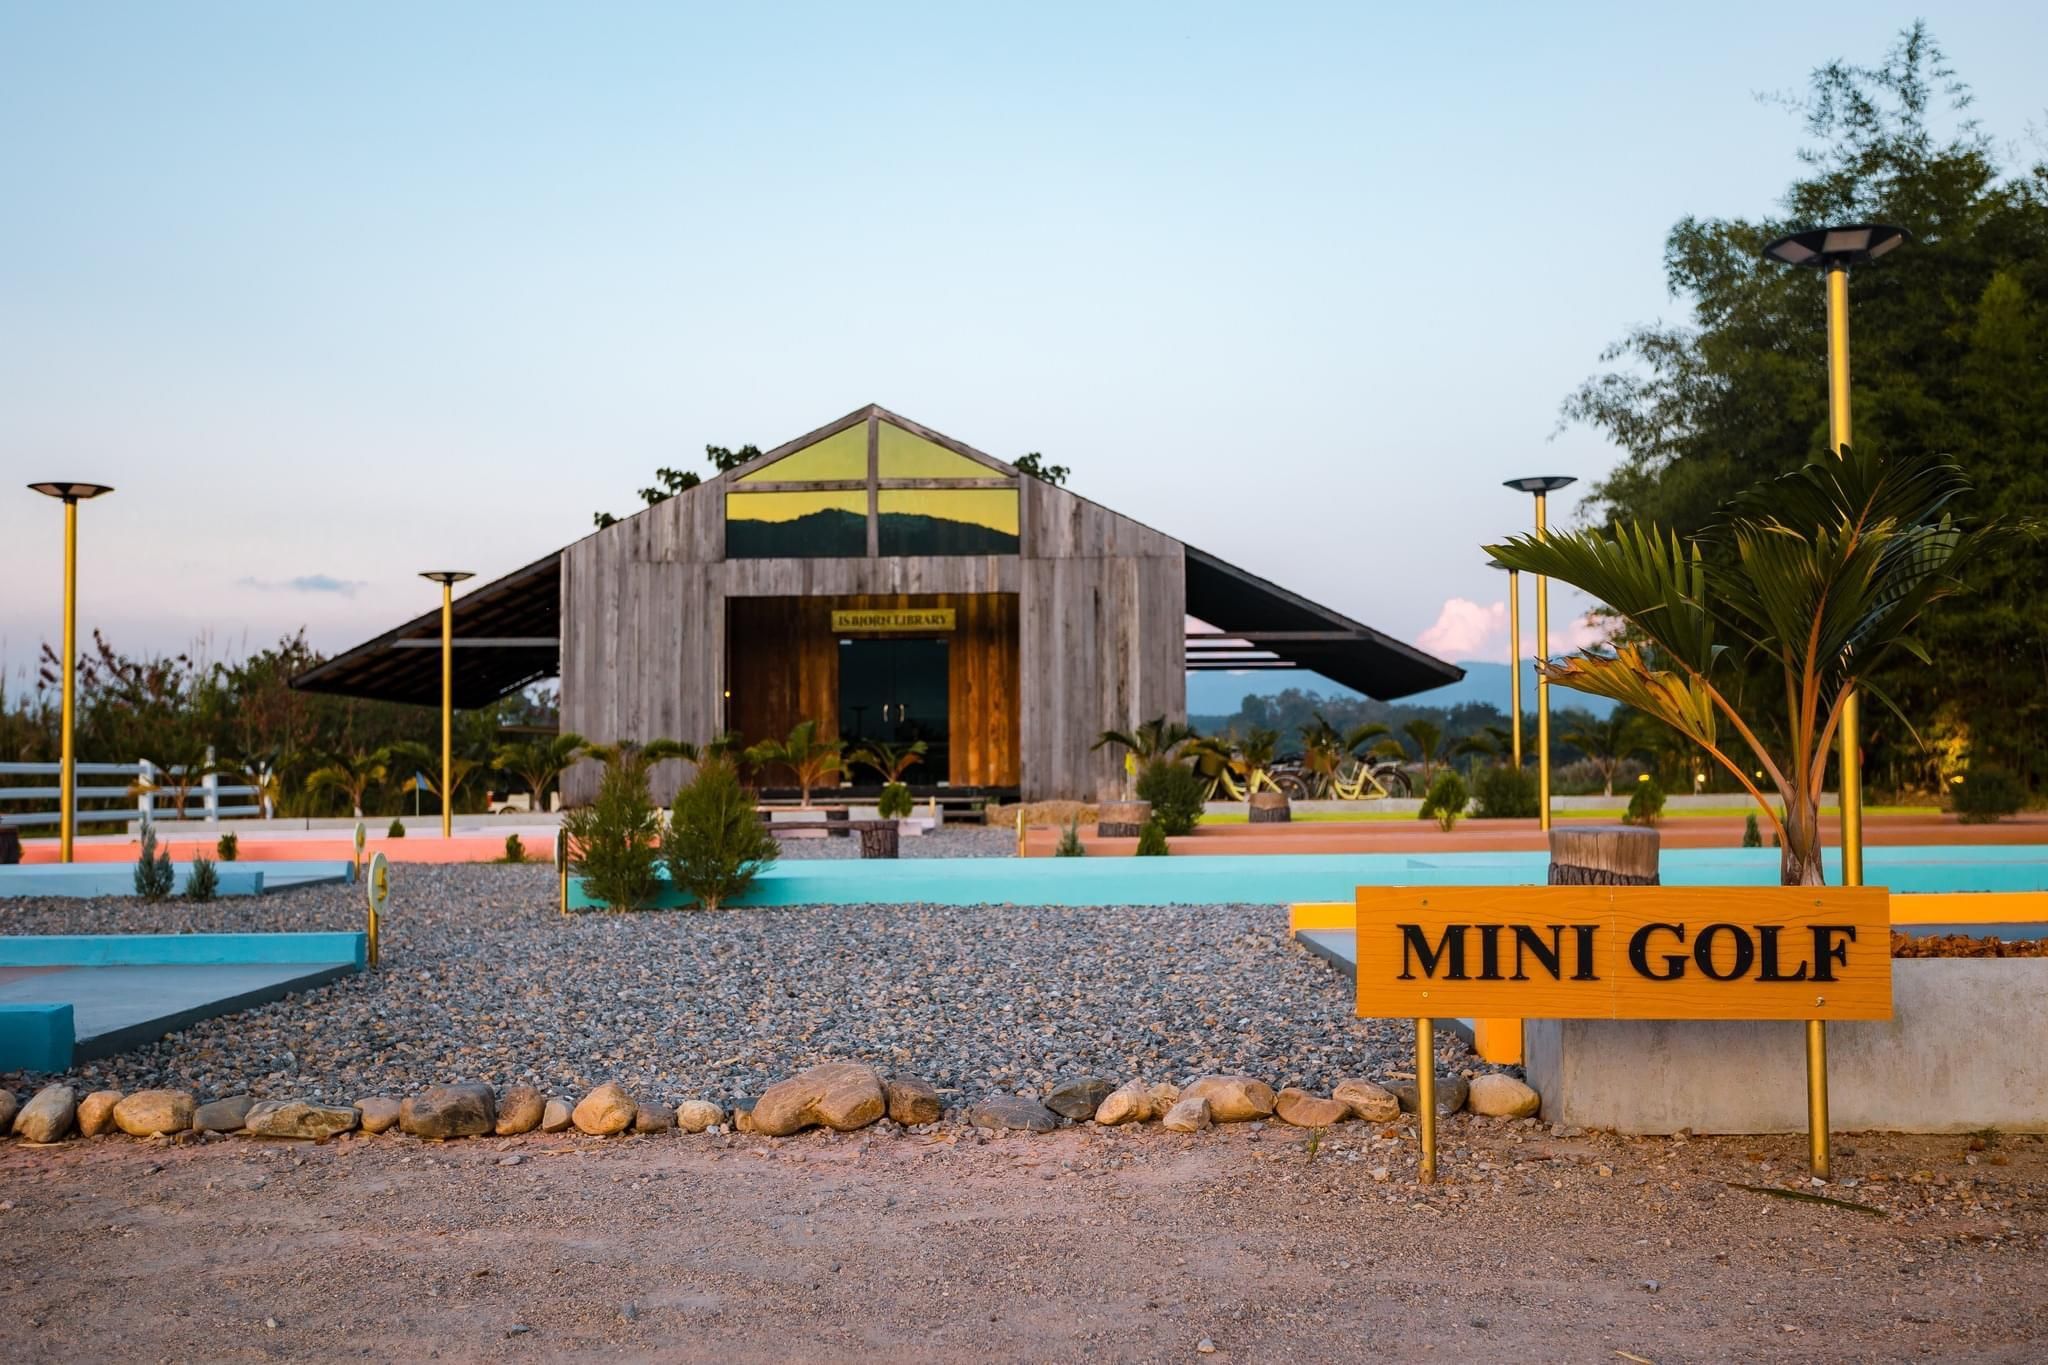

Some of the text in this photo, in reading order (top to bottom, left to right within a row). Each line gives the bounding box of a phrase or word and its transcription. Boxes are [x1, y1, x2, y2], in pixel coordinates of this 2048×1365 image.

[894, 614, 947, 625] LIBRARY
[1396, 923, 1857, 982] MINI GOLF
